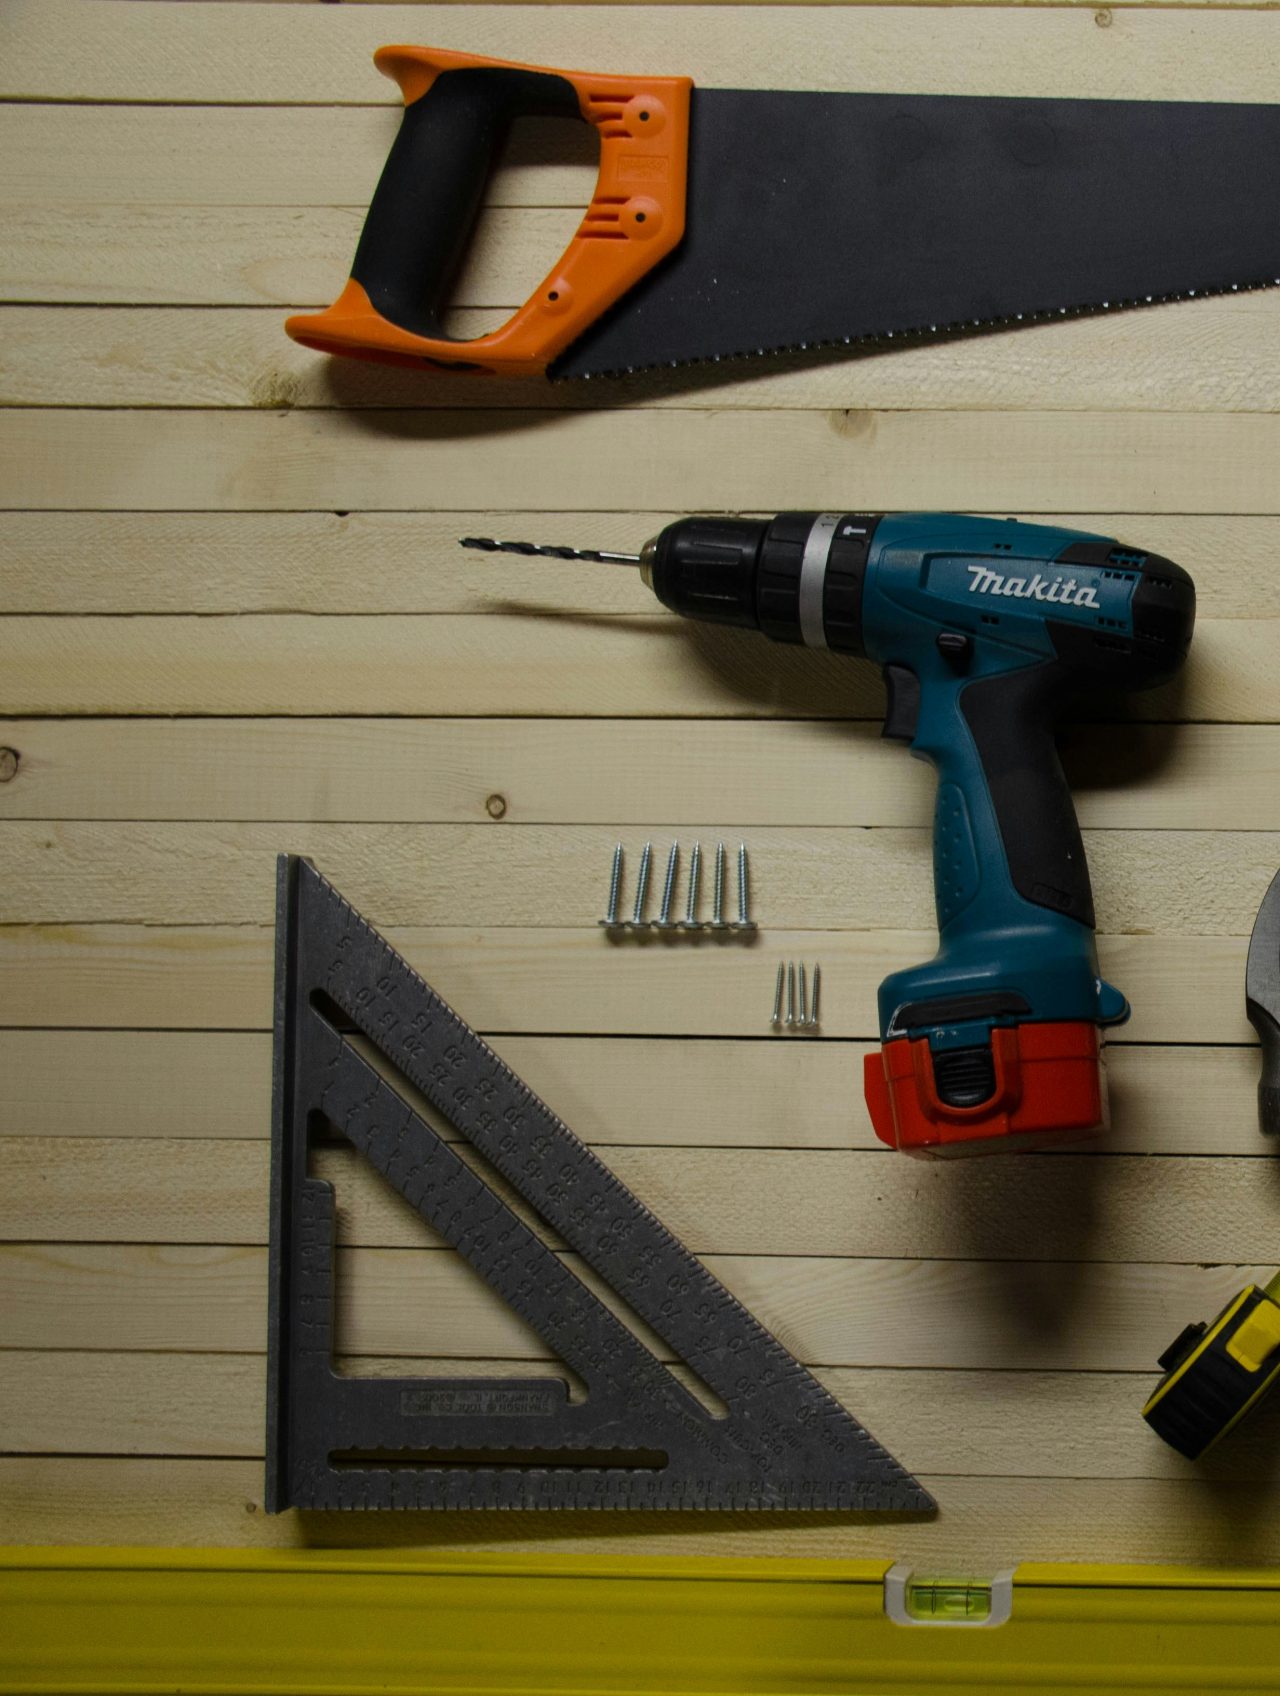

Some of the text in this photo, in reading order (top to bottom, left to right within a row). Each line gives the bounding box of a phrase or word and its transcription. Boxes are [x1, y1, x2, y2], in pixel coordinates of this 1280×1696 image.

[967, 565, 1100, 609] Makita
[336, 936, 351, 950] 5
[328, 959, 343, 973] 5
[355, 987, 376, 1008] 10
[376, 976, 398, 997] 10
[378, 1011, 400, 1032] 15
[411, 1012, 433, 1034] 15
[402, 1034, 425, 1058] 20
[443, 1045, 467, 1068] 20
[429, 1062, 452, 1087] 25
[452, 1087, 473, 1111] 30
[474, 1077, 498, 1100] 25
[475, 1111, 498, 1135] 35
[503, 1106, 528, 1130] 30
[500, 1135, 520, 1157] 40
[530, 1136, 553, 1159] 35
[521, 1159, 544, 1180] 45
[559, 1163, 580, 1185] 40
[545, 1182, 568, 1206] 50
[585, 1193, 609, 1214] 45
[570, 1207, 592, 1231] 55
[611, 1216, 634, 1240] 50
[596, 1234, 621, 1257] 60
[638, 1245, 663, 1267] 55
[627, 1268, 651, 1289] 65
[667, 1273, 691, 1296] 60
[659, 1298, 682, 1319] 70
[694, 1302, 719, 1326] 65
[695, 1336, 718, 1356] 75
[727, 1336, 751, 1357] 70
[735, 1375, 758, 1400] 80
[794, 1404, 818, 1429] 80
